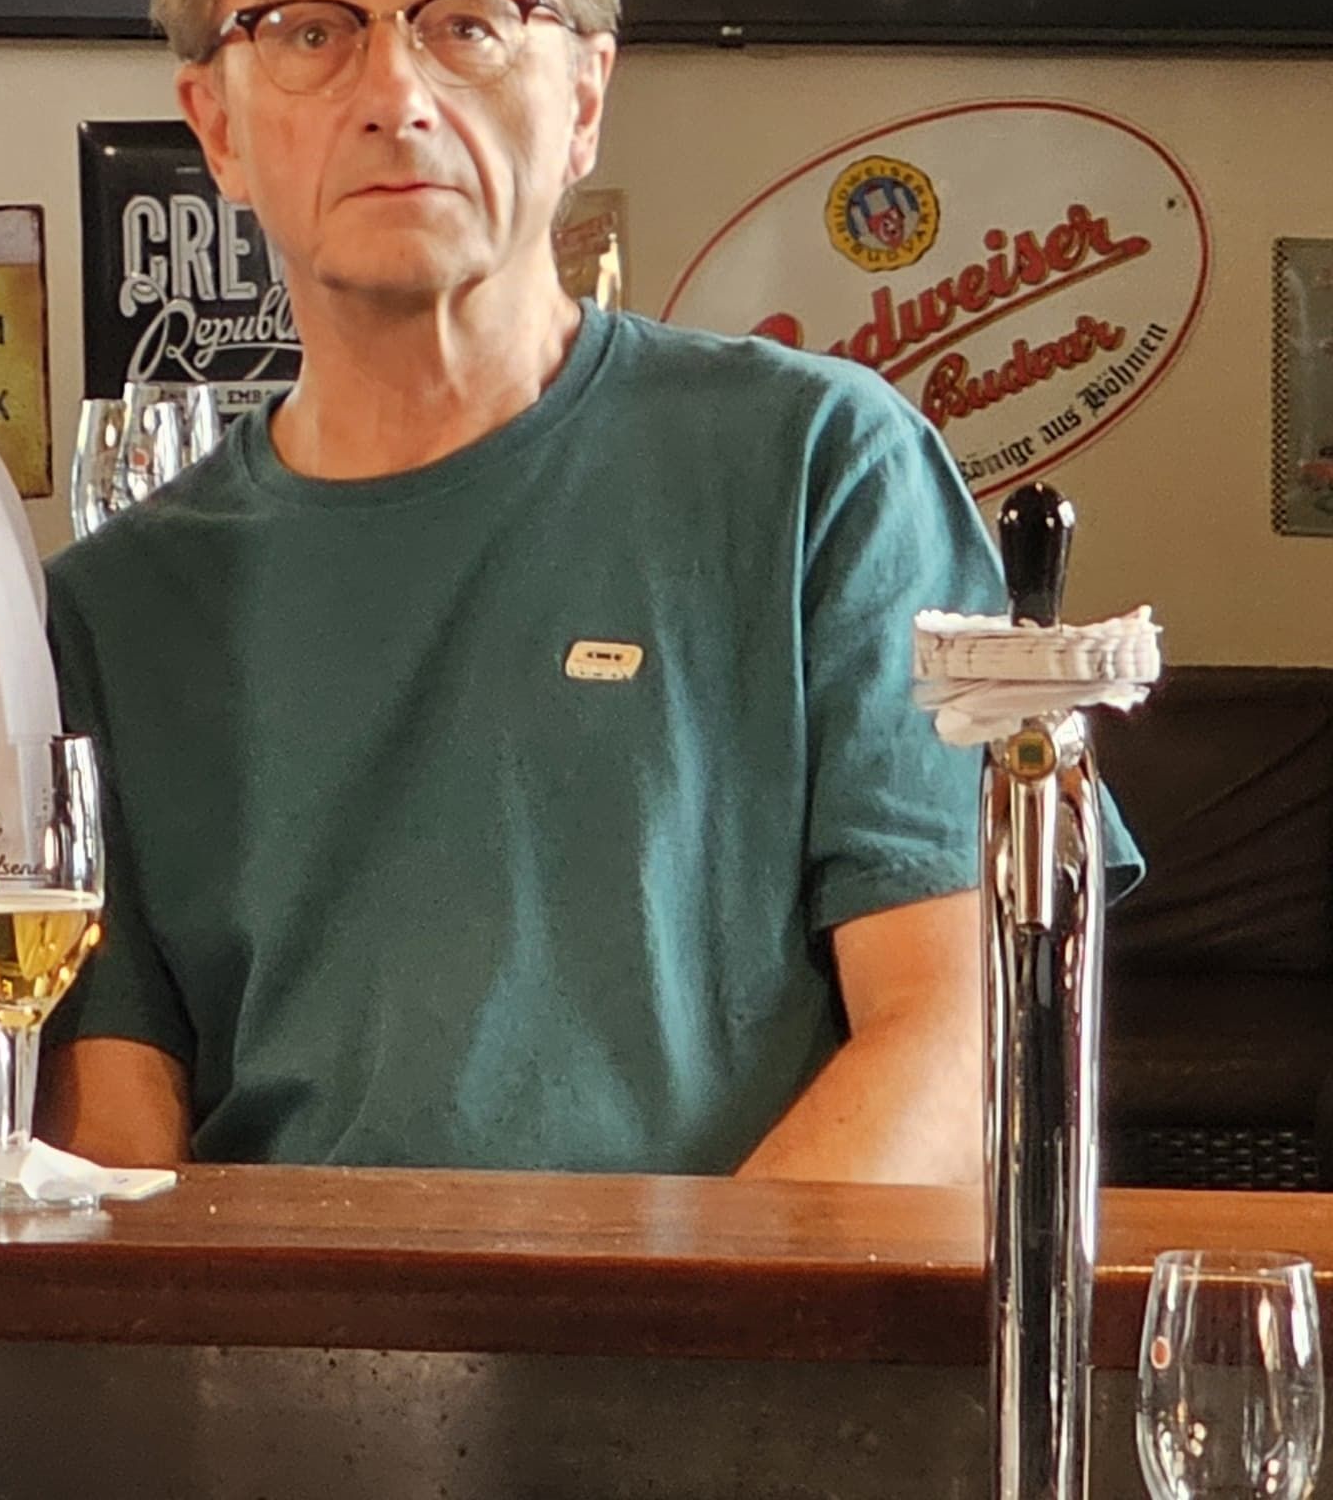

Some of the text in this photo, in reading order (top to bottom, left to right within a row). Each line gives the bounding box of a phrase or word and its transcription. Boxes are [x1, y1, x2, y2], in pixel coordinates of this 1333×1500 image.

[120, 273, 301, 381] Republ
[750, 204, 1152, 366] dweiser
[1039, 405, 1083, 444] aus
[1076, 323, 1169, 417] Böhmen
